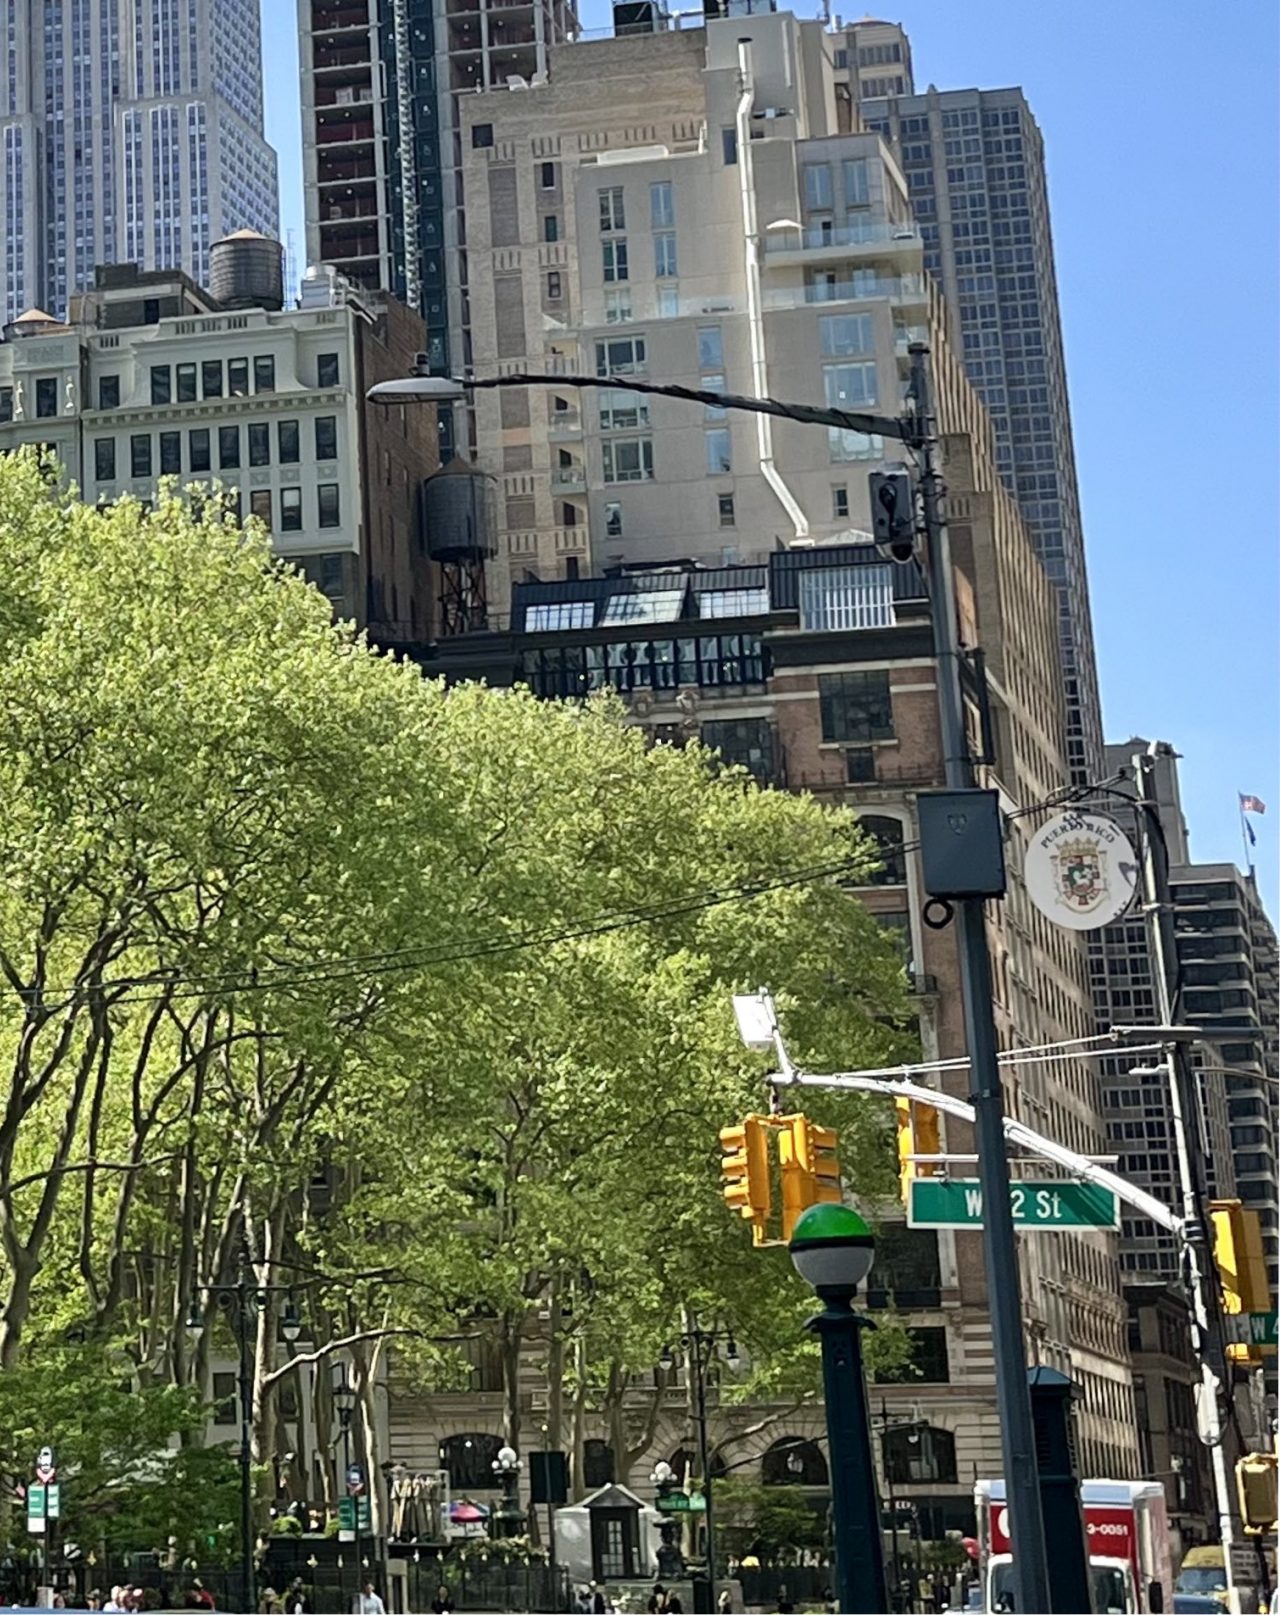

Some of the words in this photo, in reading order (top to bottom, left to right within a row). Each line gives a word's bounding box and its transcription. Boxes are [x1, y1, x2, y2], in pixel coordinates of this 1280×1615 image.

[1086, 823, 1115, 843] RICO
[964, 1189, 982, 1217] W
[1036, 1191, 1062, 1218] St
[1251, 1316, 1266, 1340] W
